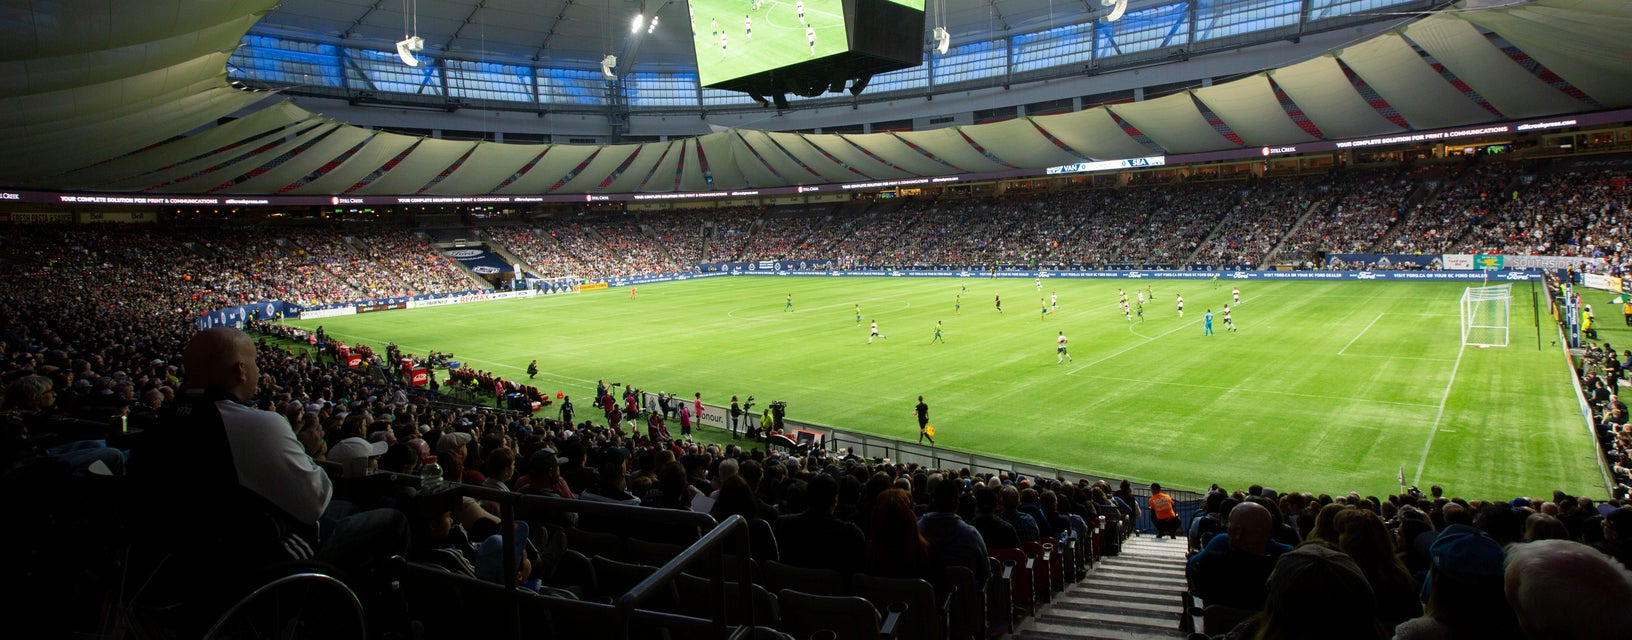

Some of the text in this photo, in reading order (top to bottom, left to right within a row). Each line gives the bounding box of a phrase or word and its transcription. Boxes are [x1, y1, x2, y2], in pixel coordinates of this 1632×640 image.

[1382, 135, 1412, 143] SOLUTION
[1450, 126, 1508, 137] COMMUNICATIONS
[1506, 272, 1528, 280] Ford
[460, 294, 490, 303] RE/MAX
[701, 412, 724, 424] onour.
